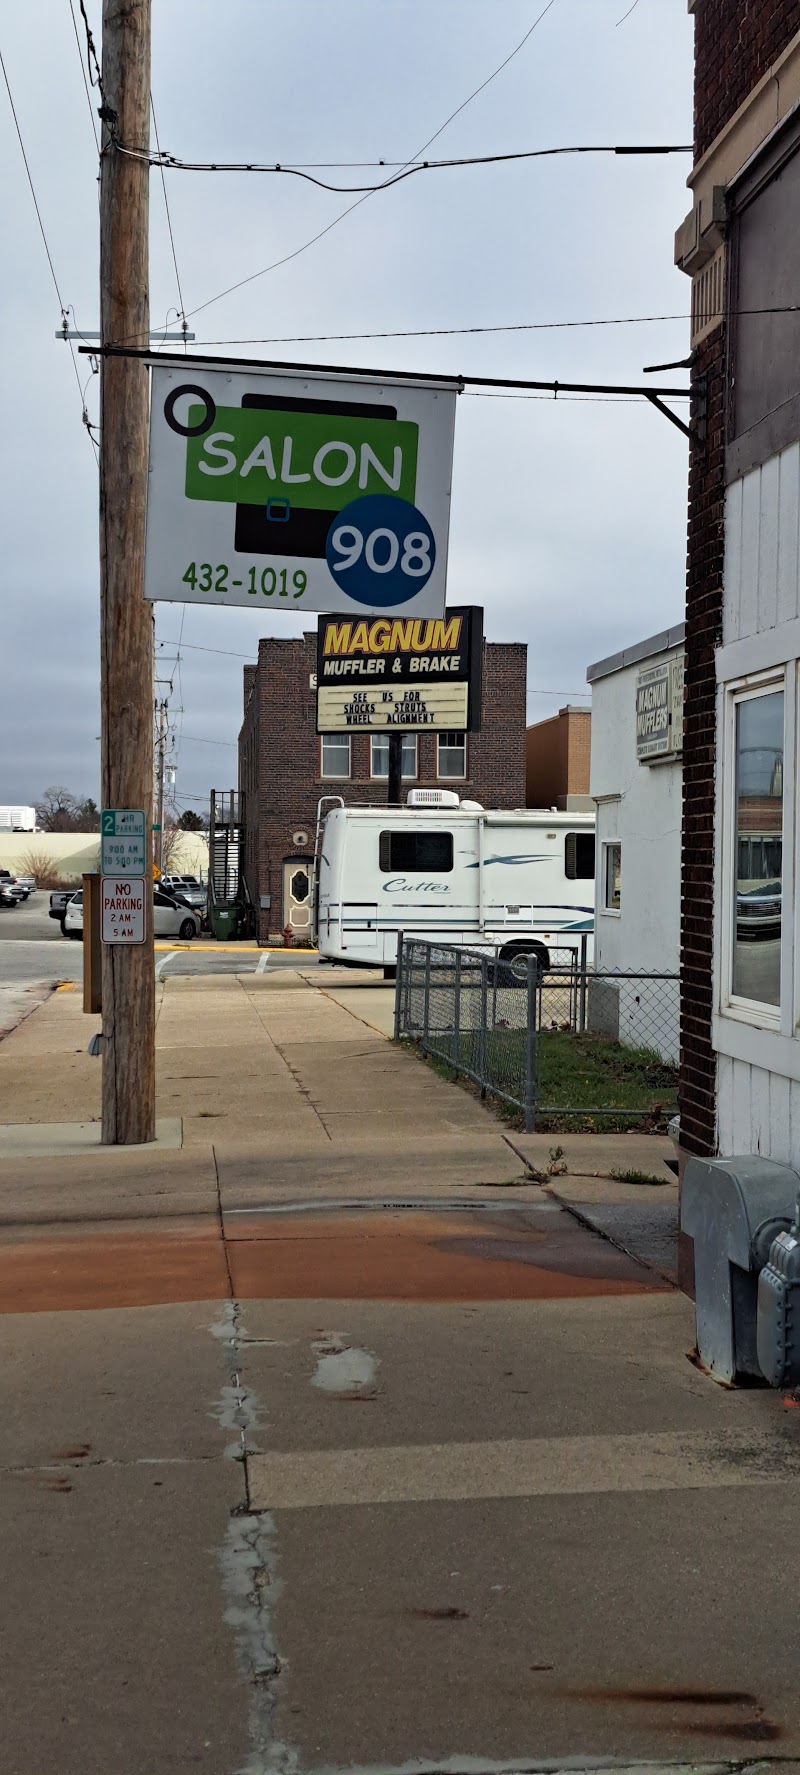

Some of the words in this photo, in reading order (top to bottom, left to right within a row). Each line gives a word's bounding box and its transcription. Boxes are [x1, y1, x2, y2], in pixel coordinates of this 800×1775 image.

[198, 431, 403, 491] SALON
[331, 525, 431, 577] 908
[182, 562, 307, 599] 432-1019
[323, 616, 463, 656] MAGNUM
[324, 658, 386, 676] MUFFLER
[391, 657, 402, 673] &
[409, 656, 461, 672] BRAKE
[353, 692, 367, 703] SEE
[382, 691, 393, 702] US
[404, 691, 420, 701] FOR
[638, 681, 668, 712] MAGNUM
[344, 703, 375, 714] SHOCKS
[394, 702, 426, 713] STRUTS
[346, 714, 372, 725] WHEEL
[386, 713, 435, 724] ALIGNMENT
[637, 706, 668, 737] MUFFLERS
[104, 816, 113, 832] 2
[123, 814, 135, 823] HR
[116, 825, 143, 833] PARKING
[109, 845, 125, 854] 9:00
[128, 845, 138, 854] AM
[104, 857, 113, 865] TO
[116, 857, 131, 866] 5:00
[134, 857, 144, 865] PM
[115, 883, 131, 896] NO
[382, 878, 451, 892] Cutter
[104, 898, 142, 910] PARKING
[110, 914, 116, 922] 2
